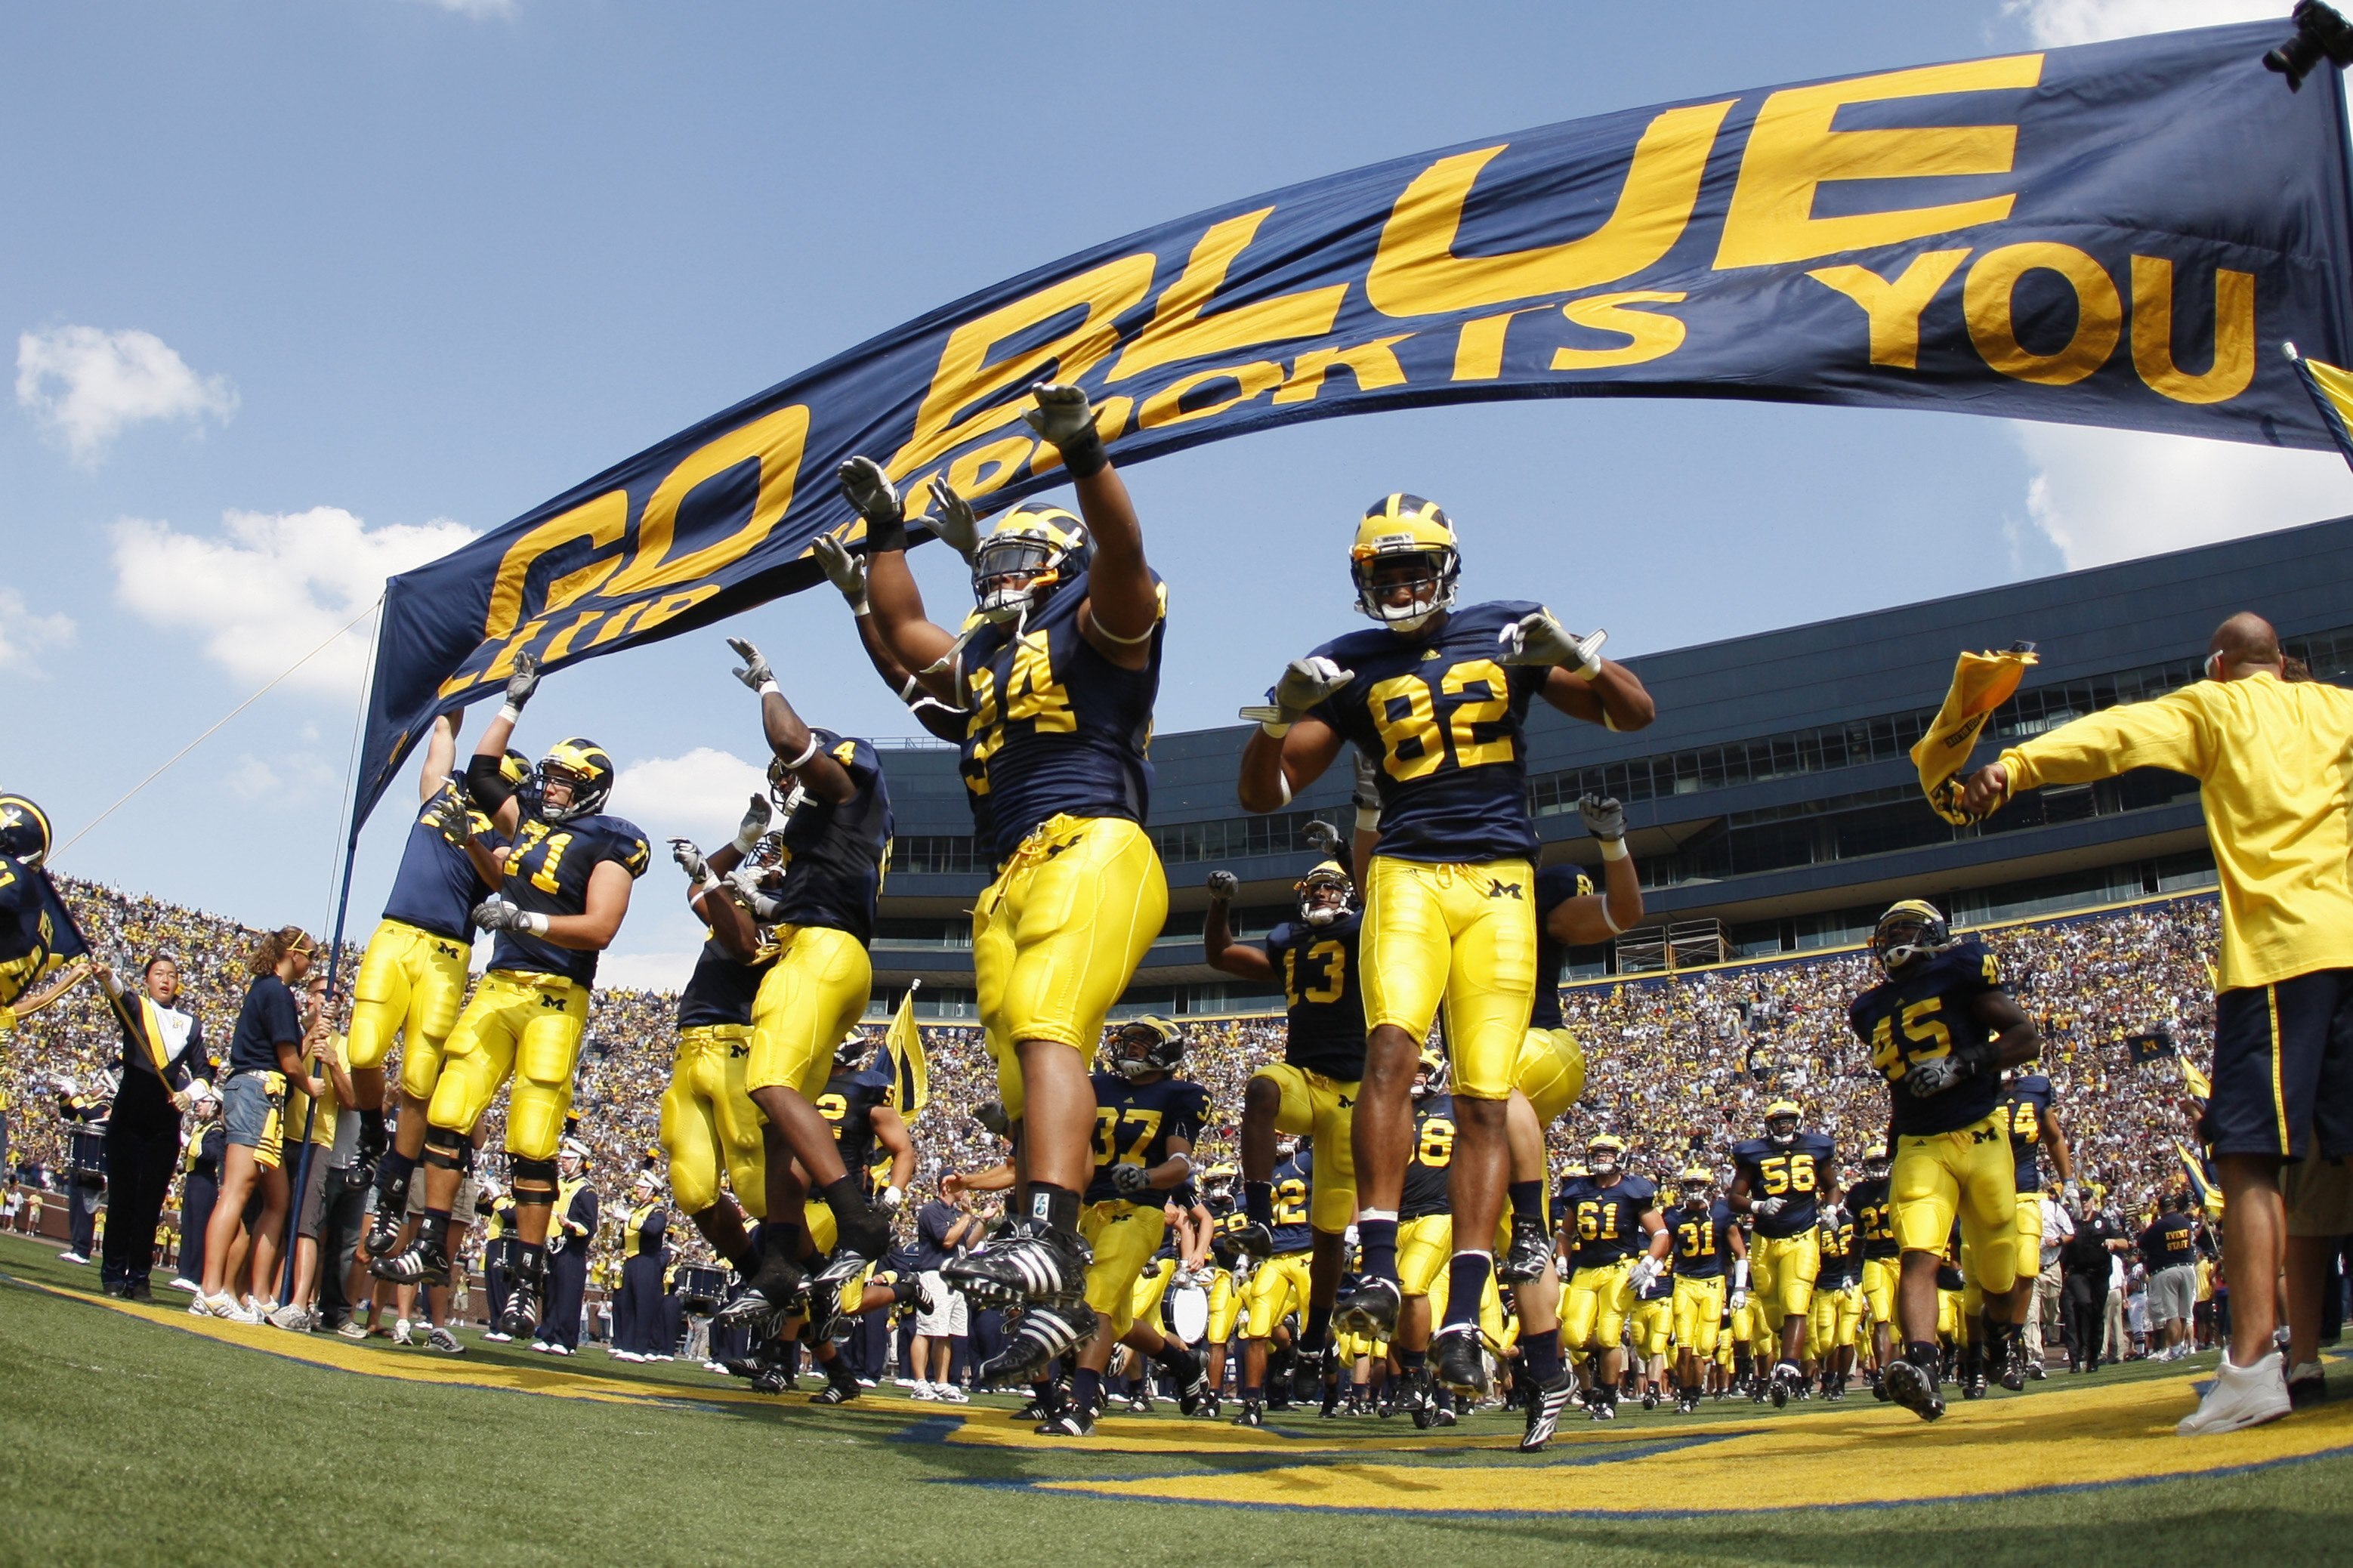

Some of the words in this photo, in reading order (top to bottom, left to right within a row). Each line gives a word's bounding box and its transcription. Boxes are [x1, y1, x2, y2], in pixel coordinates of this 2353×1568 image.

[1805, 241, 2256, 405] YOU
[484, 403, 811, 642] GO
[882, 53, 2046, 483] BLUE
[1366, 659, 1515, 782] 82
[833, 740, 857, 766] 4
[504, 819, 574, 895] 71
[1490, 879, 1524, 901] M
[437, 941, 459, 959] M
[1283, 940, 1346, 1008] 13
[541, 993, 567, 1012] M
[1871, 995, 1952, 1082] 45
[1094, 1106, 1163, 1168] 37
[1971, 1126, 1998, 1145] M
[1759, 1153, 1817, 1196] 56
[1576, 1201, 1619, 1241] 61
[1678, 1221, 1716, 1258] 31
[2165, 1229, 2189, 1240] EVENT
[2166, 1239, 2189, 1252] STAFF
[1706, 1281, 1718, 1289] M
